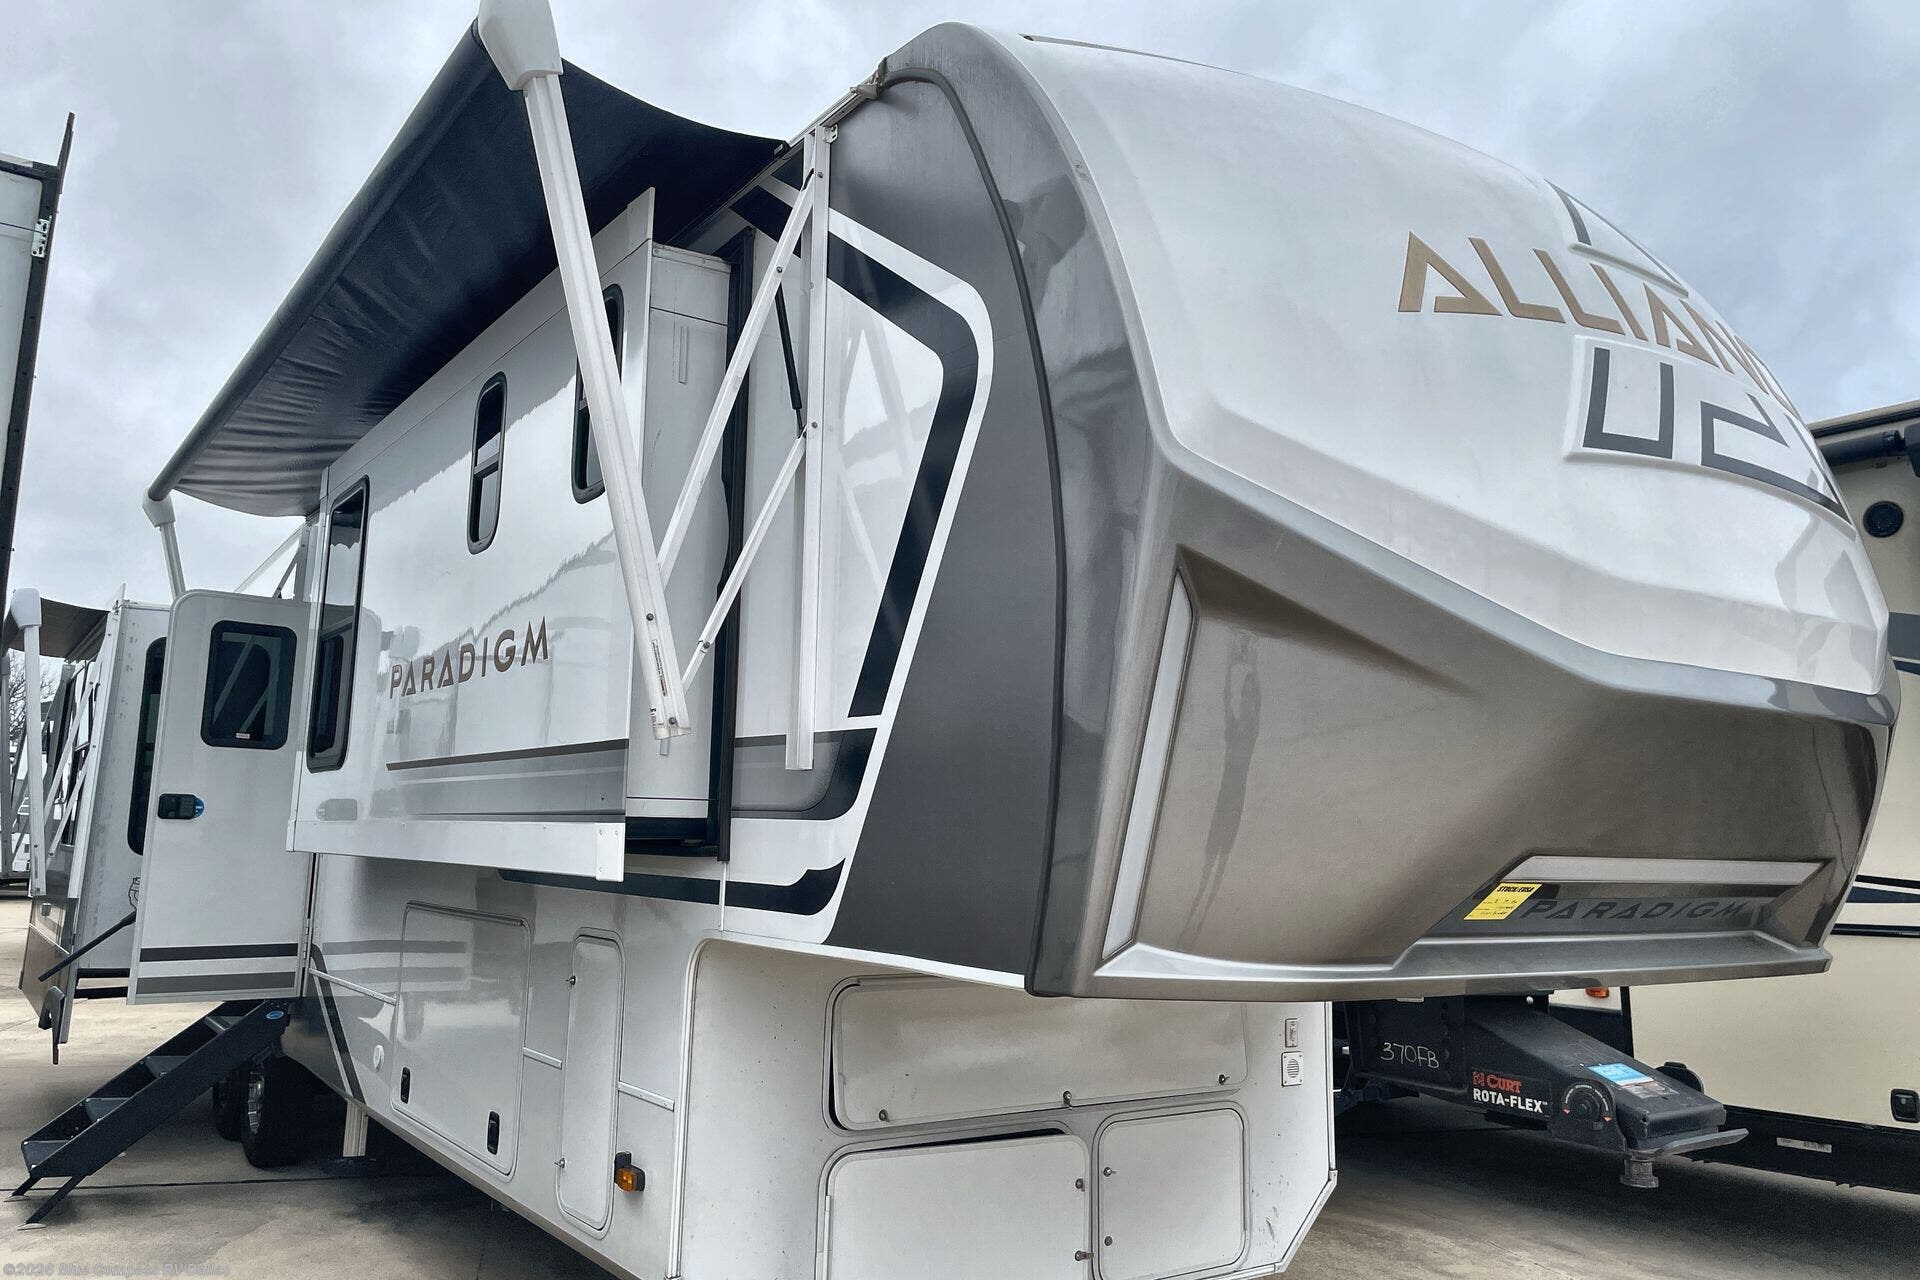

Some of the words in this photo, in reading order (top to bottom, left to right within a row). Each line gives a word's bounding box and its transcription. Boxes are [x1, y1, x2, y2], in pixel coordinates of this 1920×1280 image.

[389, 616, 549, 699] PARADIGM
[1519, 899, 1747, 920] PARADIGM
[1380, 1042, 1440, 1069] 370FB
